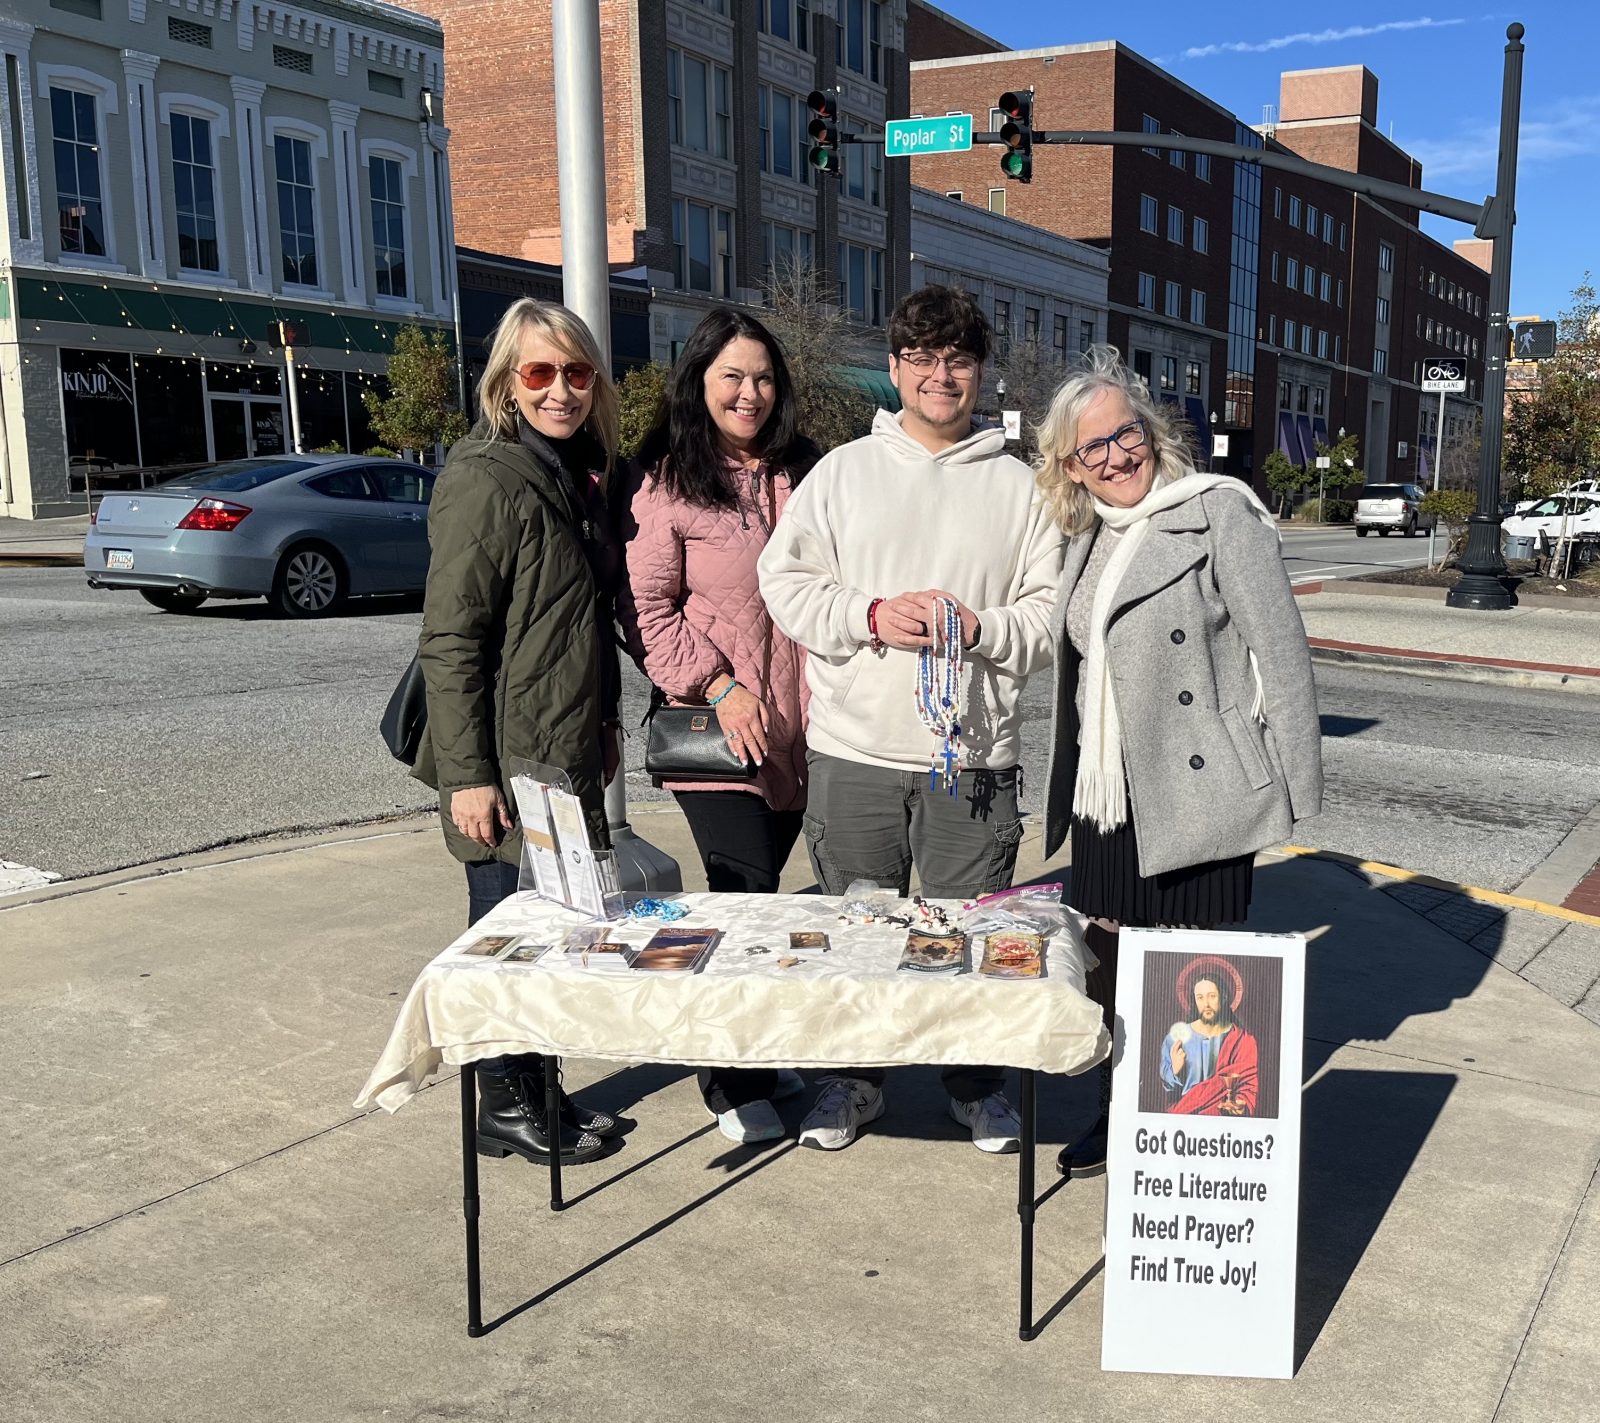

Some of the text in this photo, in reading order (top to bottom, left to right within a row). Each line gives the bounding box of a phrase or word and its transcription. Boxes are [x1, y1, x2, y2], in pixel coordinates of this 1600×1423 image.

[893, 124, 964, 150] Poplar St
[63, 372, 107, 394] KINJO
[1427, 381, 1460, 389] BIKE LANE
[1135, 1127, 1274, 1160] Got Questions?
[1133, 1170, 1267, 1202] Free Literature
[1132, 1212, 1255, 1249] Need Prayer?
[1130, 1254, 1257, 1293] Find True Joy!
